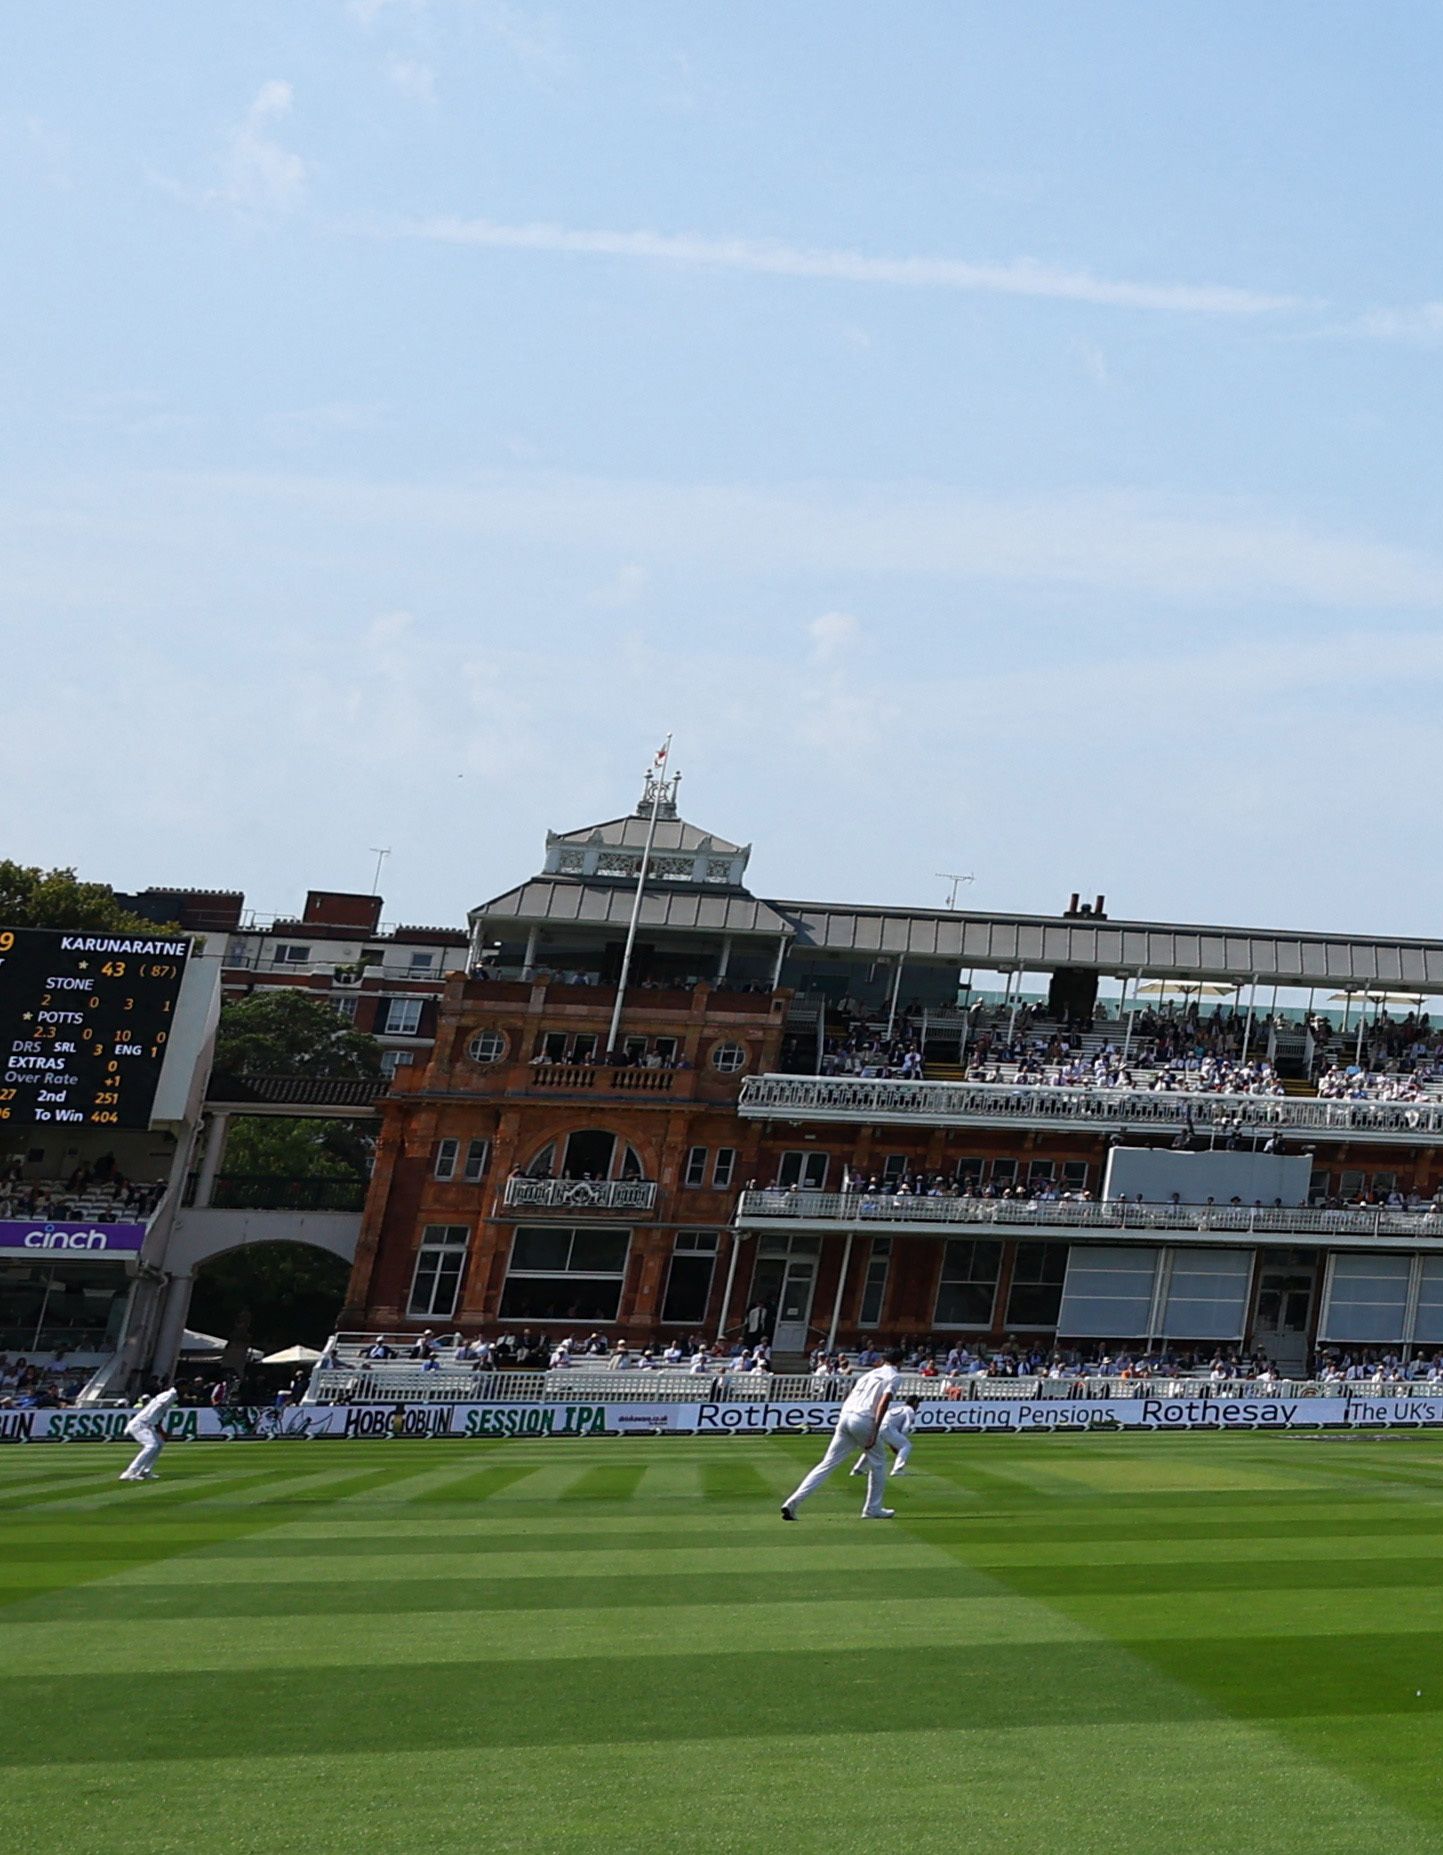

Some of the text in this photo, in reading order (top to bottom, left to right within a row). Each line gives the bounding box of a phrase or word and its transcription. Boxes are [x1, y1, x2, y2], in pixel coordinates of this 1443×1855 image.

[61, 936, 186, 956] KARUNARATNE
[101, 962, 126, 977] 43
[45, 977, 94, 991] STONE
[41, 994, 171, 1012] 2 0 3 1
[37, 1011, 83, 1024] POTTS
[34, 1026, 166, 1043] 2.3 0 10 0
[12, 1041, 157, 1057] DRS SRL 3 ENG 1
[8, 1056, 118, 1072] EXTRAS 0
[5, 1071, 40, 1083] Over
[44, 1072, 78, 1085] Rate
[37, 1090, 66, 1102] 2nd
[95, 1092, 118, 1104] 251
[34, 1108, 51, 1121] To
[55, 1109, 83, 1122] Win
[91, 1112, 118, 1123] 404
[24, 1224, 107, 1250] cinch
[465, 1409, 551, 1433] SESSION
[564, 1406, 606, 1431] IPA
[697, 1404, 842, 1428] Rothesa
[1019, 1405, 1115, 1424] Pensions
[1142, 1400, 1297, 1424] Rothesay
[1351, 1403, 1387, 1420] The
[1394, 1402, 1435, 1420] UK's
[48, 1414, 131, 1437] SESSIO
[168, 1410, 197, 1437] PA
